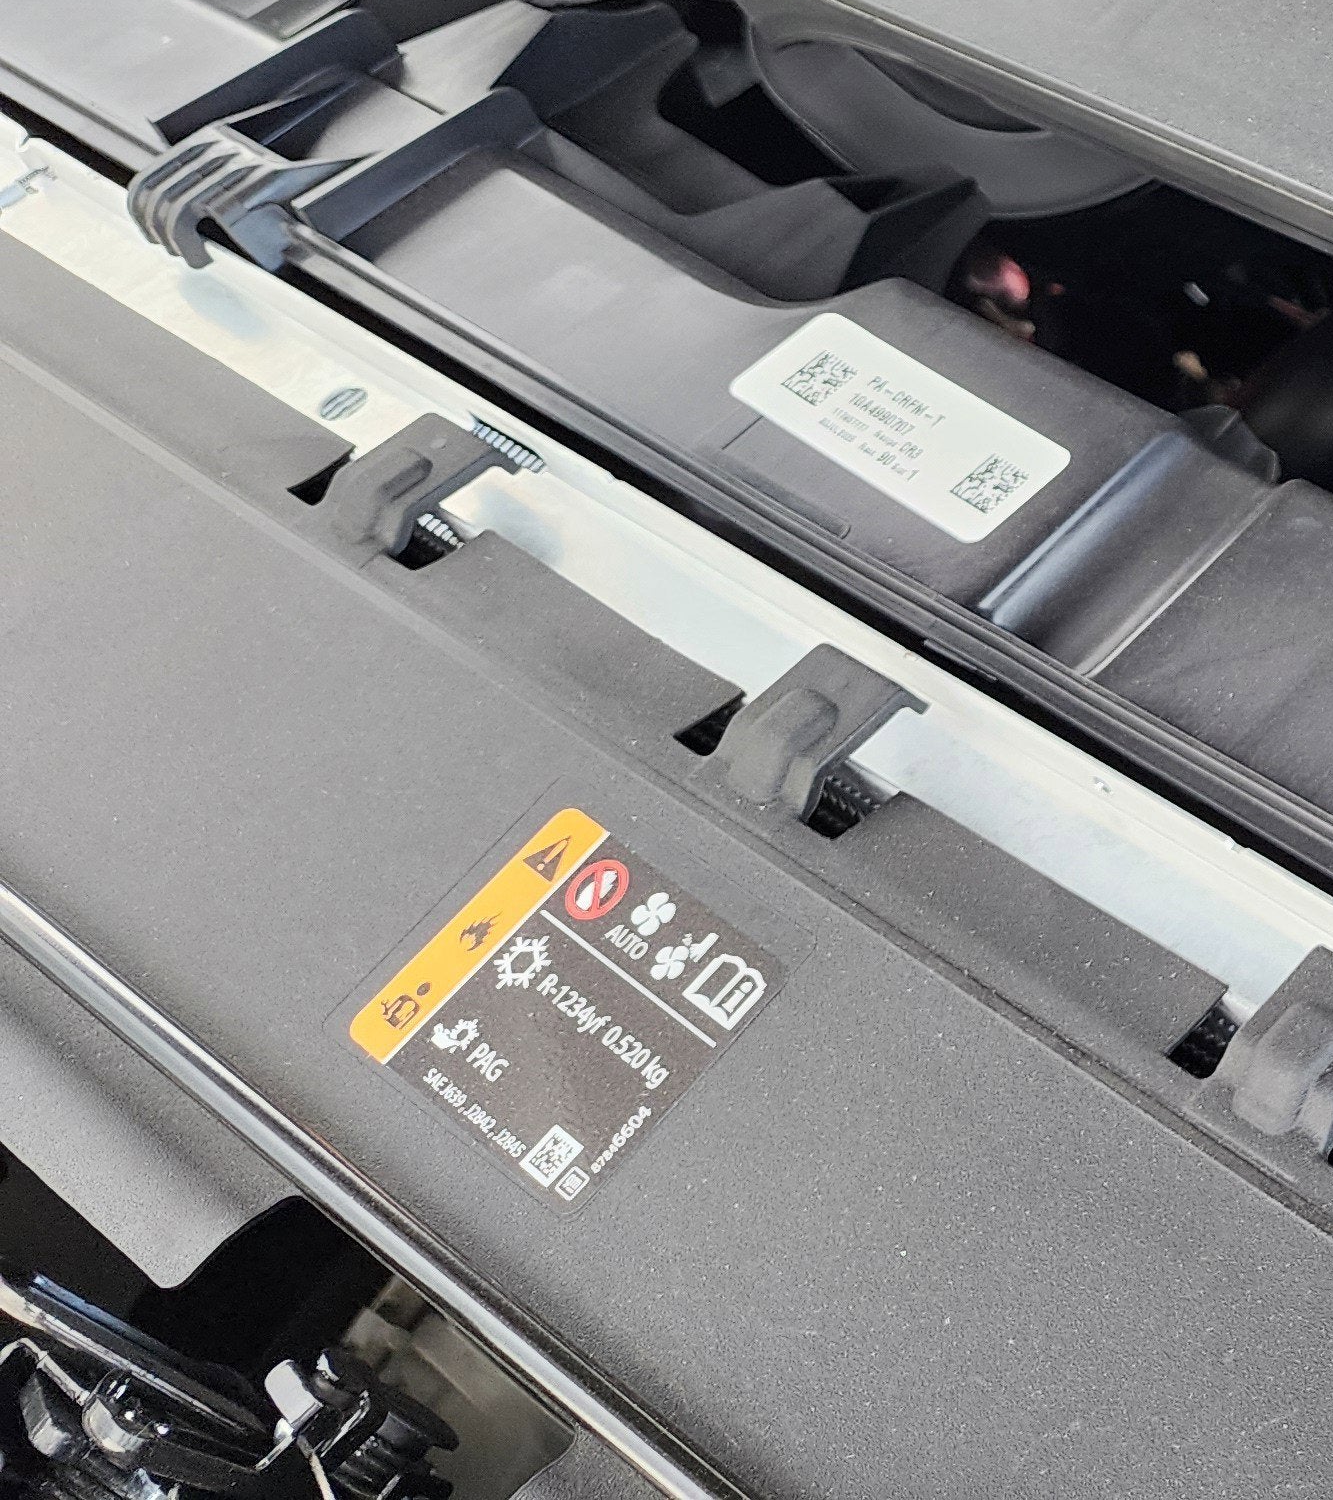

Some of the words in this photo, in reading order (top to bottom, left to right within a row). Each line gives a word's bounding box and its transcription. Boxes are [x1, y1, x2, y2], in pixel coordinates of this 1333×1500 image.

[604, 924, 649, 960] AUTO
[466, 1042, 510, 1082] PAG
[536, 973, 612, 1035] R-1234yf
[601, 1026, 651, 1069] 0.520
[641, 1055, 670, 1090] kg
[422, 1067, 449, 1092] SAE
[491, 1127, 527, 1158] J2845
